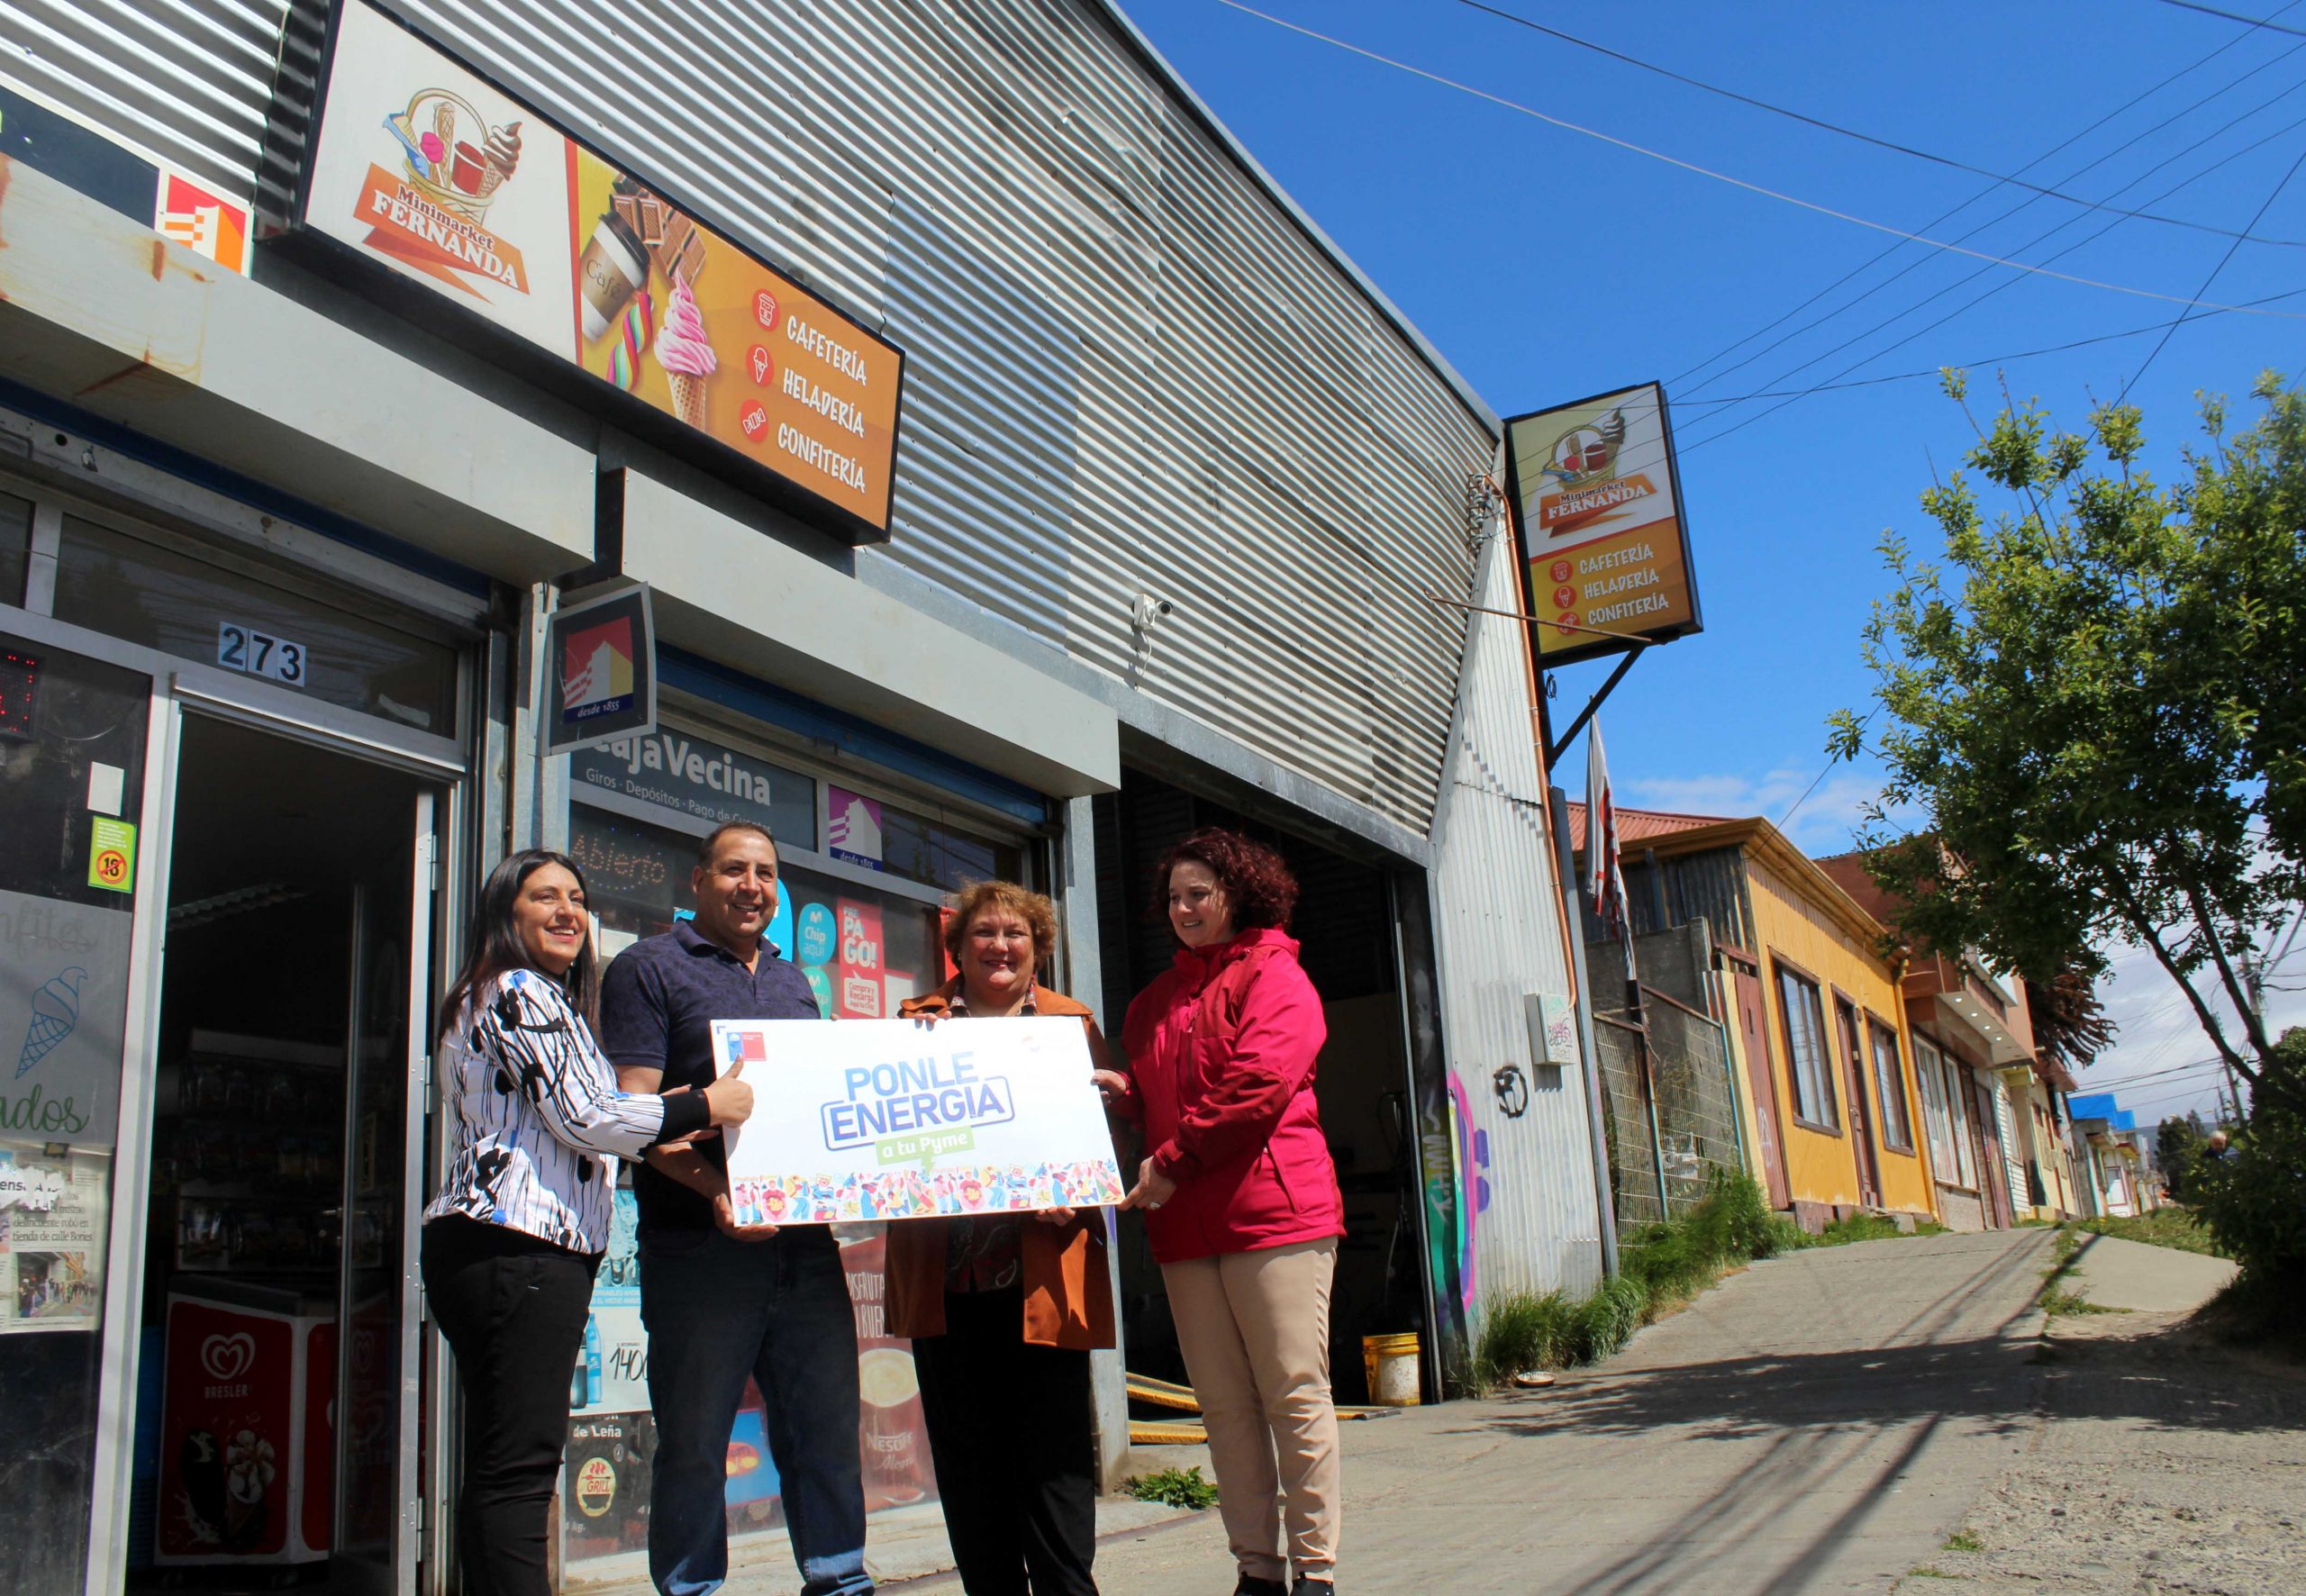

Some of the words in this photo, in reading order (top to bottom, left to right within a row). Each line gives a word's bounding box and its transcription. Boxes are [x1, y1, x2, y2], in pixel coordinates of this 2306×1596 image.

[397, 185, 494, 251] Minimarket
[372, 189, 519, 289] FERNANDA
[586, 258, 621, 300] Café
[787, 315, 867, 386] CAFETERÍA
[783, 367, 865, 438] HELADERÍA
[777, 422, 866, 494] CONFITERÍA
[1547, 484, 1651, 520] FERNANDA
[1559, 481, 1626, 504] Minimarket
[1579, 543, 1654, 575] CAFETERÍA
[1584, 568, 1659, 600] HELADERÍA
[1588, 593, 1669, 626] CONFITERÍA
[222, 627, 301, 681] 273
[577, 704, 601, 718] desde
[603, 701, 620, 712] 1855
[586, 767, 616, 789] Giros
[626, 779, 680, 807] Depósitos
[688, 799, 715, 821] Pago
[717, 808, 731, 821] de
[568, 834, 666, 884] Abierto
[804, 926, 826, 944] Chip
[844, 916, 864, 939] PA
[844, 937, 877, 969] GO!
[845, 1051, 979, 1102] PONLE
[882, 1145, 894, 1158] a
[897, 1139, 916, 1156] tu
[919, 1131, 968, 1155] Pyme
[13, 1231, 38, 1241] tienda
[40, 1231, 50, 1241] de
[51, 1231, 68, 1241] calle
[70, 1231, 93, 1241] Bories
[204, 1384, 249, 1399] BRESLER
[573, 1425, 588, 1437] de
[591, 1424, 622, 1437] Leña
[587, 1480, 610, 1493] GRILL
